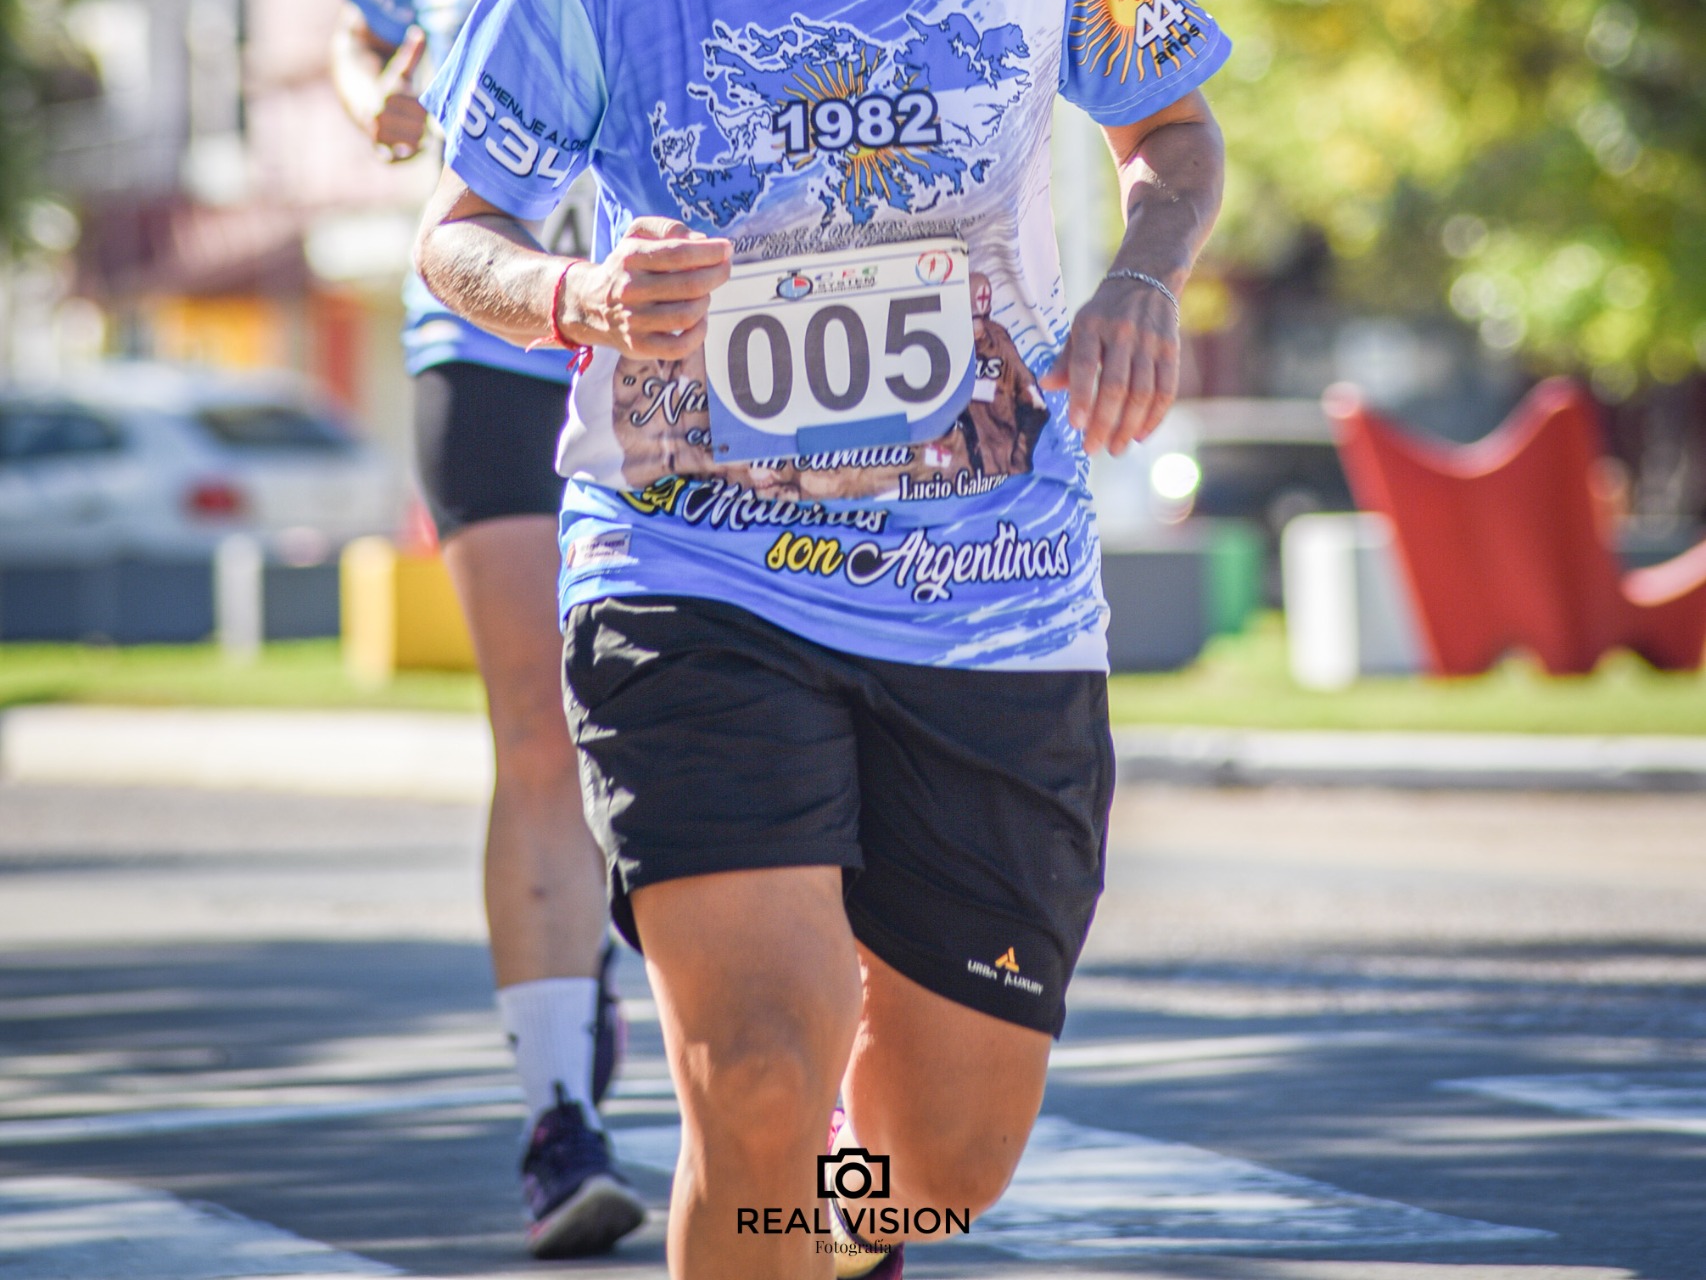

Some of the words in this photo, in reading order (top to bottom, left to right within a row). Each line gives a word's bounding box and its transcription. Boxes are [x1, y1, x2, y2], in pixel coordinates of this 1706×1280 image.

[1154, 23, 1200, 65] años
[544, 130, 558, 145] A
[772, 89, 942, 153] 1982
[728, 294, 951, 419] 005
[899, 472, 952, 501] Lucio
[767, 531, 844, 576] son
[847, 520, 1070, 604] Argentinas
